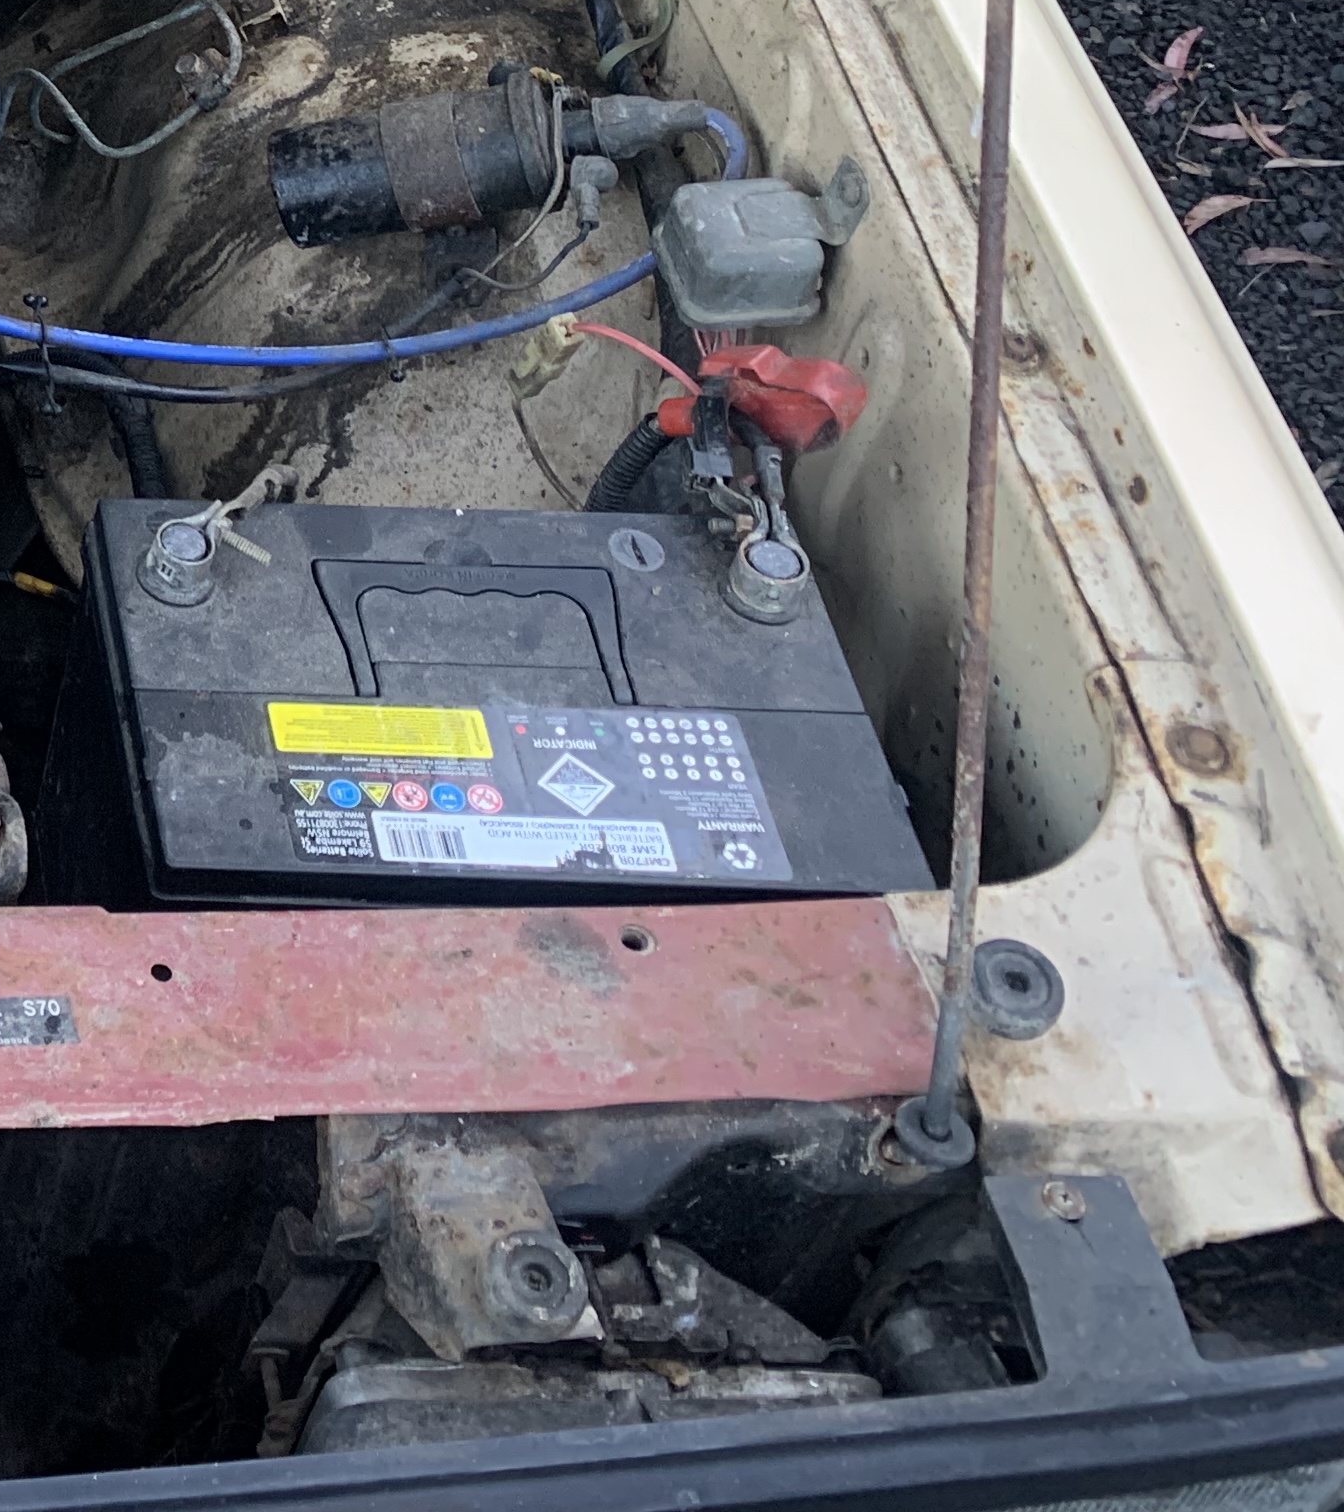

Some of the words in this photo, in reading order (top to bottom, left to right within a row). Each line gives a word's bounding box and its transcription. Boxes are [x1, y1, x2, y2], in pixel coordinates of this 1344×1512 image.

[532, 737, 597, 750] INDICATOR
[294, 809, 366, 819] www.solite.com.au
[698, 820, 765, 832] WARRANTY
[307, 828, 330, 837] NSW
[332, 829, 370, 839] Belmore
[487, 829, 510, 838] ACID
[515, 830, 542, 838] WITH
[316, 838, 357, 847] Lakemba
[306, 845, 346, 856] Batteries
[348, 847, 374, 857] Solite
[22, 999, 60, 1016] S70
